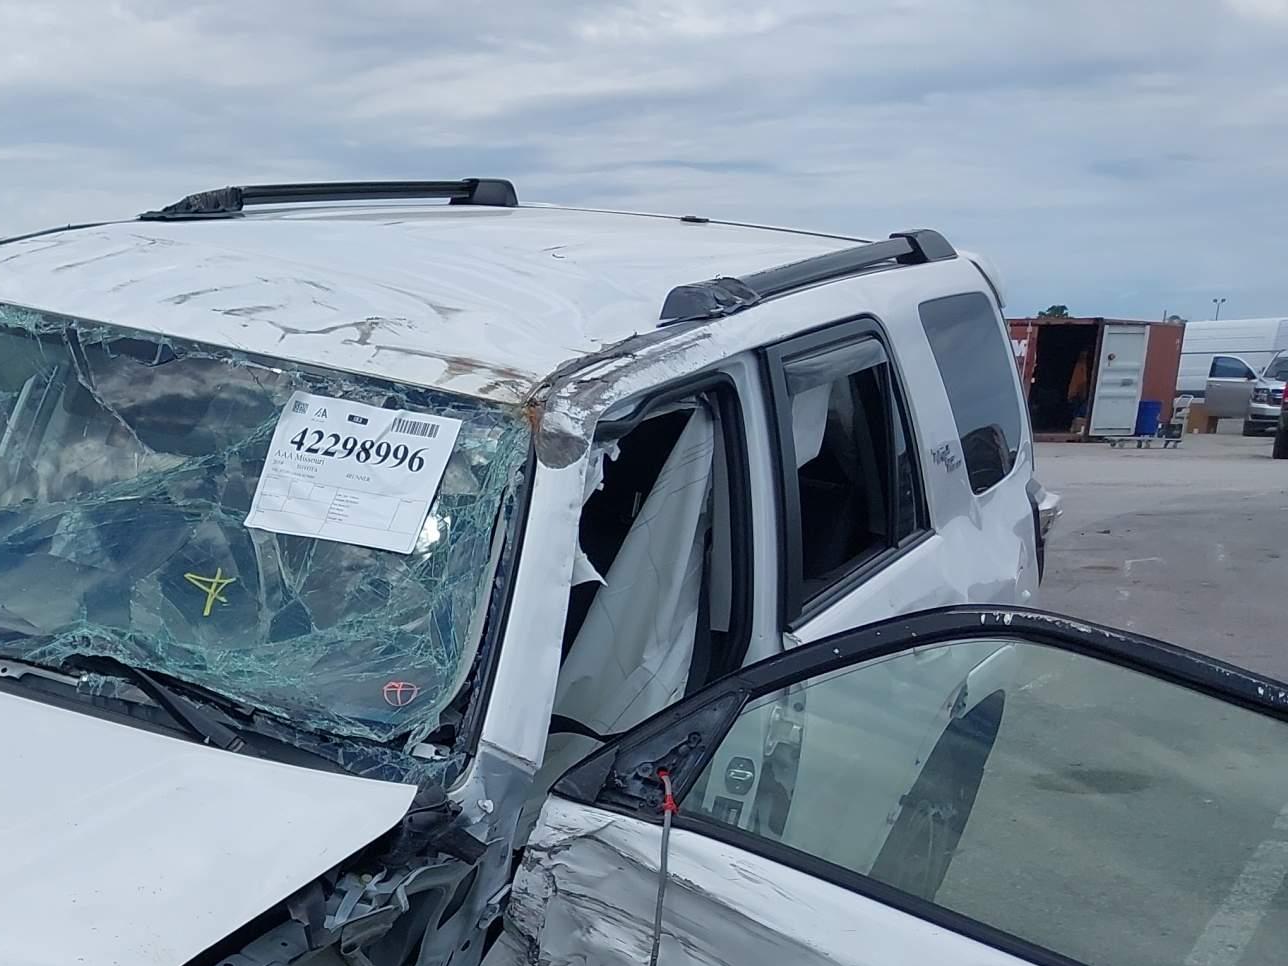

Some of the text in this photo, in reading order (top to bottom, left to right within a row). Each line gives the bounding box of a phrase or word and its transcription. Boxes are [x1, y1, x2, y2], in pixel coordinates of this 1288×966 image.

[274, 450, 326, 466] AAA Missouri
[290, 427, 430, 473] 42298996
